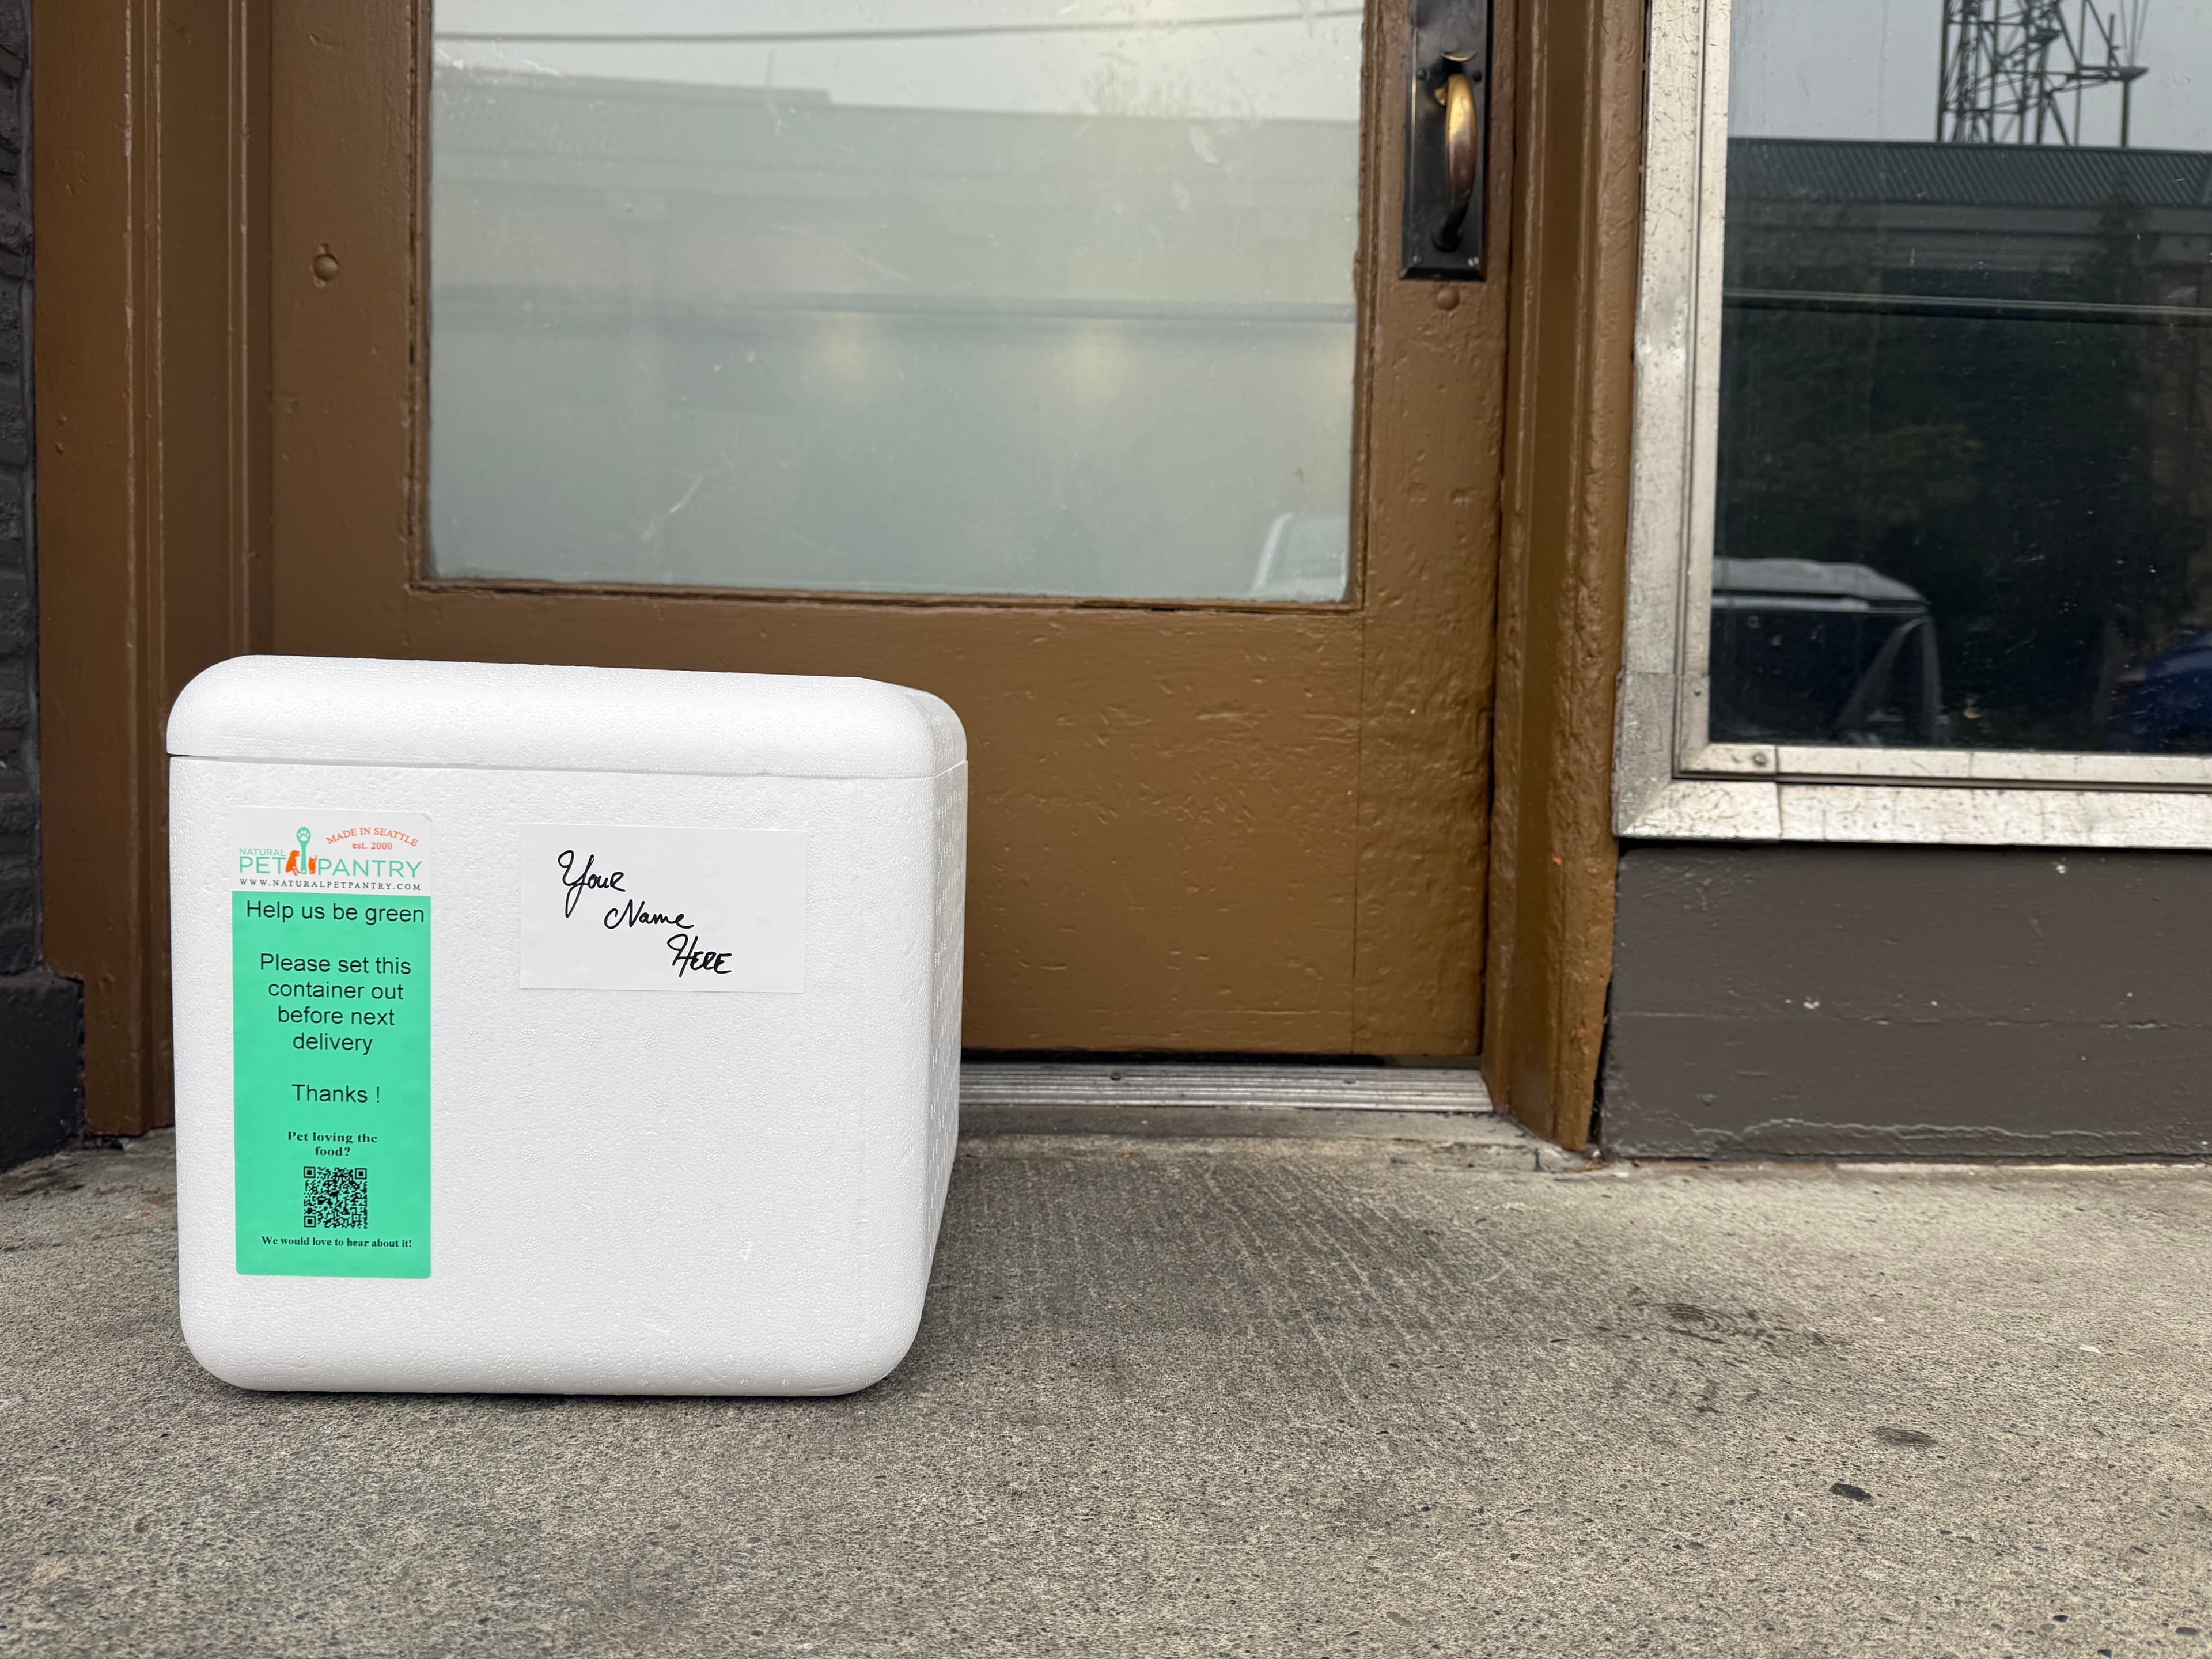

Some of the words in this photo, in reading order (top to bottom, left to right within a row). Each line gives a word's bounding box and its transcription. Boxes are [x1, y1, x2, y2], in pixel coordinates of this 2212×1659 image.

[326, 828, 358, 844] MADE
[359, 827, 371, 835] IN
[374, 827, 419, 847] SEATTLE
[371, 842, 392, 850] 2000
[239, 848, 286, 857] NATURAL
[239, 856, 286, 874] PET
[317, 858, 422, 878] PANTRY
[240, 878, 421, 890] WWW.NATURALPETPANTRY.COM
[247, 900, 294, 922] Help
[302, 905, 325, 919] us
[334, 903, 358, 920] be
[365, 907, 424, 925] green
[604, 899, 694, 929] Name
[260, 953, 330, 972] Please
[338, 957, 369, 973] set
[376, 957, 411, 974] this
[268, 982, 365, 998] container
[371, 984, 404, 1000] out
[278, 1006, 343, 1024] before
[351, 1009, 395, 1025] next
[293, 1032, 373, 1055] delivery
[291, 1084, 368, 1103] Thanks
[288, 1131, 308, 1141] Pet
[313, 1132, 353, 1143] loving
[358, 1134, 377, 1142] the
[315, 1147, 351, 1156] food?
[262, 1236, 278, 1244] We
[281, 1237, 309, 1245] would
[313, 1237, 332, 1246] love
[347, 1238, 369, 1247] hear
[372, 1239, 399, 1247] about
[402, 1239, 412, 1247] it!
